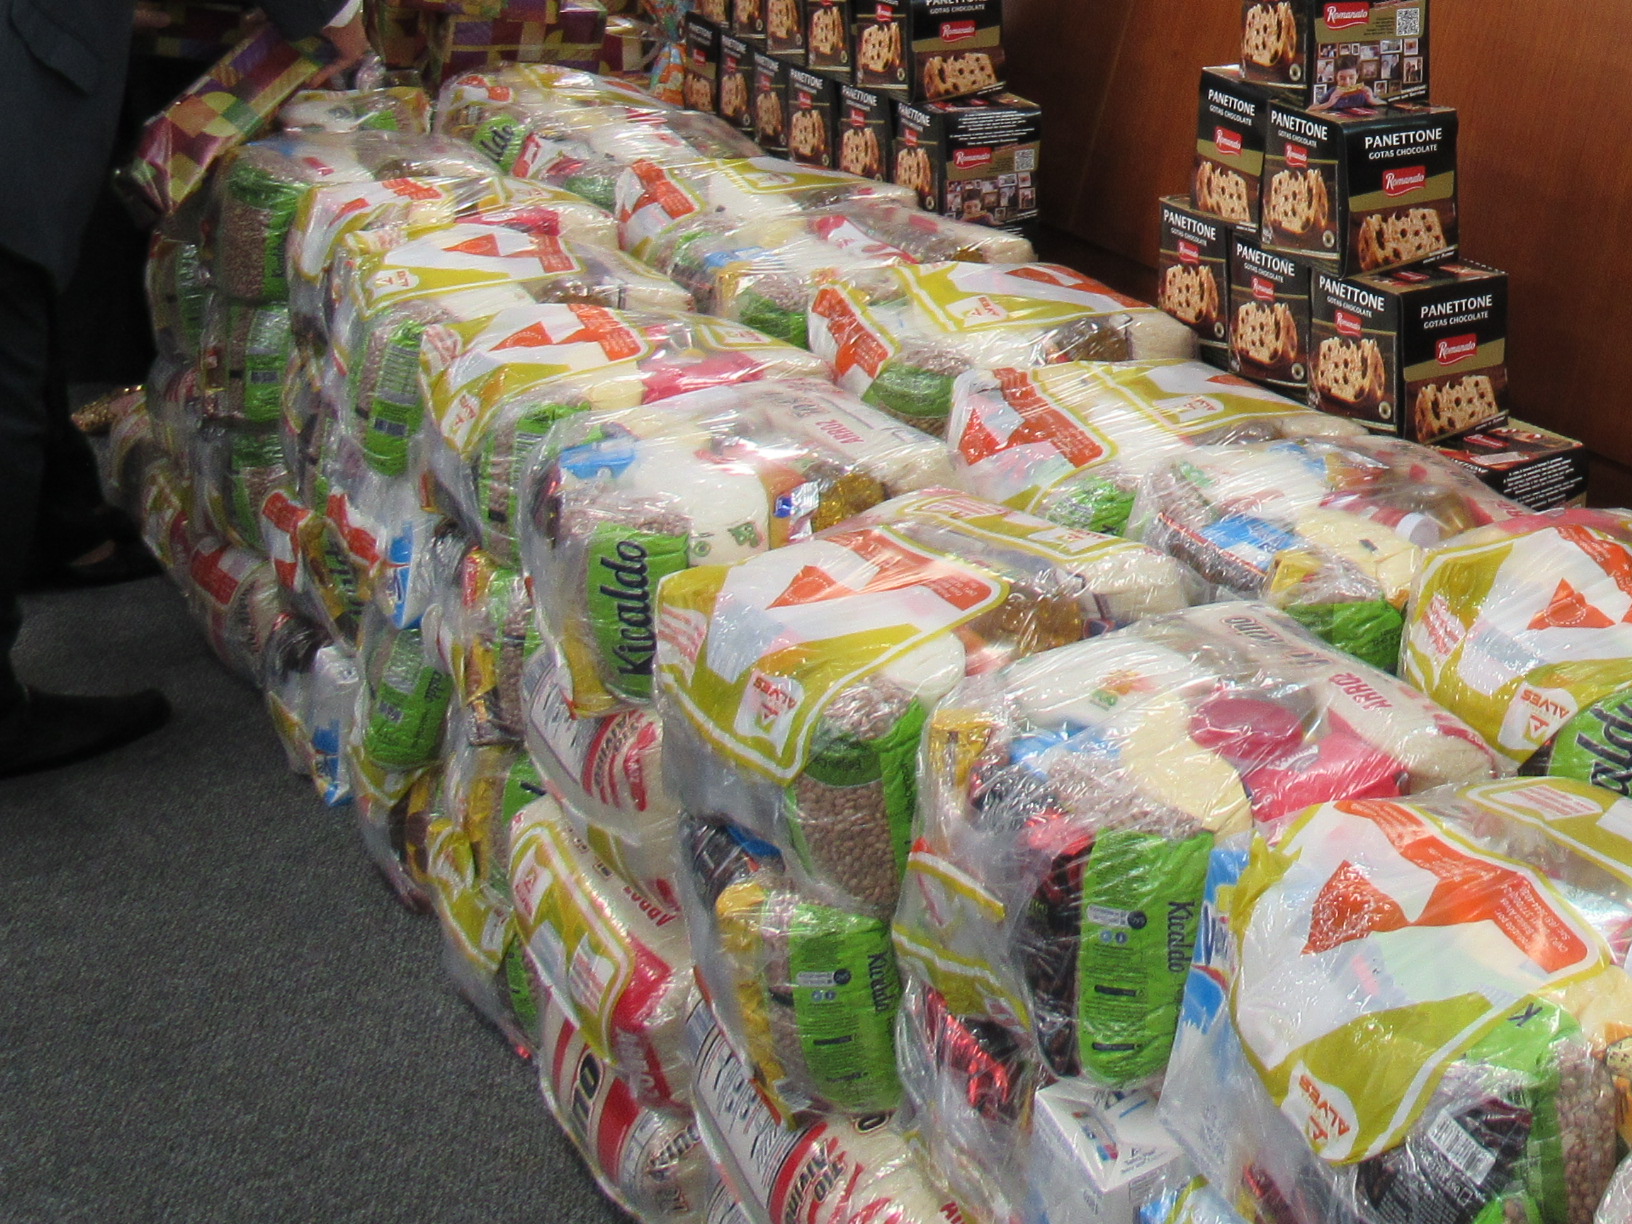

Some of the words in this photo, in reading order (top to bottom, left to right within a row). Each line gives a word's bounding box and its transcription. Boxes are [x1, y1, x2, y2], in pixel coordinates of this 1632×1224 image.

[1208, 89, 1255, 117] PANETTONE
[1271, 110, 1328, 140] PANETTONE
[1365, 128, 1443, 149] PANETTONE
[1369, 148, 1394, 160] GOTAS
[1396, 143, 1438, 157] CHOCOLATE
[1385, 172, 1424, 189] Romanato
[1163, 209, 1216, 241] PANETTONE
[1236, 243, 1295, 276] PANETTONE
[1319, 276, 1385, 312] PANETTONE
[1420, 295, 1492, 318] PANETTONE
[1449, 311, 1488, 324] CHOCOLATE
[600, 539, 658, 679] Kicaldo
[752, 675, 798, 710] ALVES
[1519, 688, 1571, 720] ALVES
